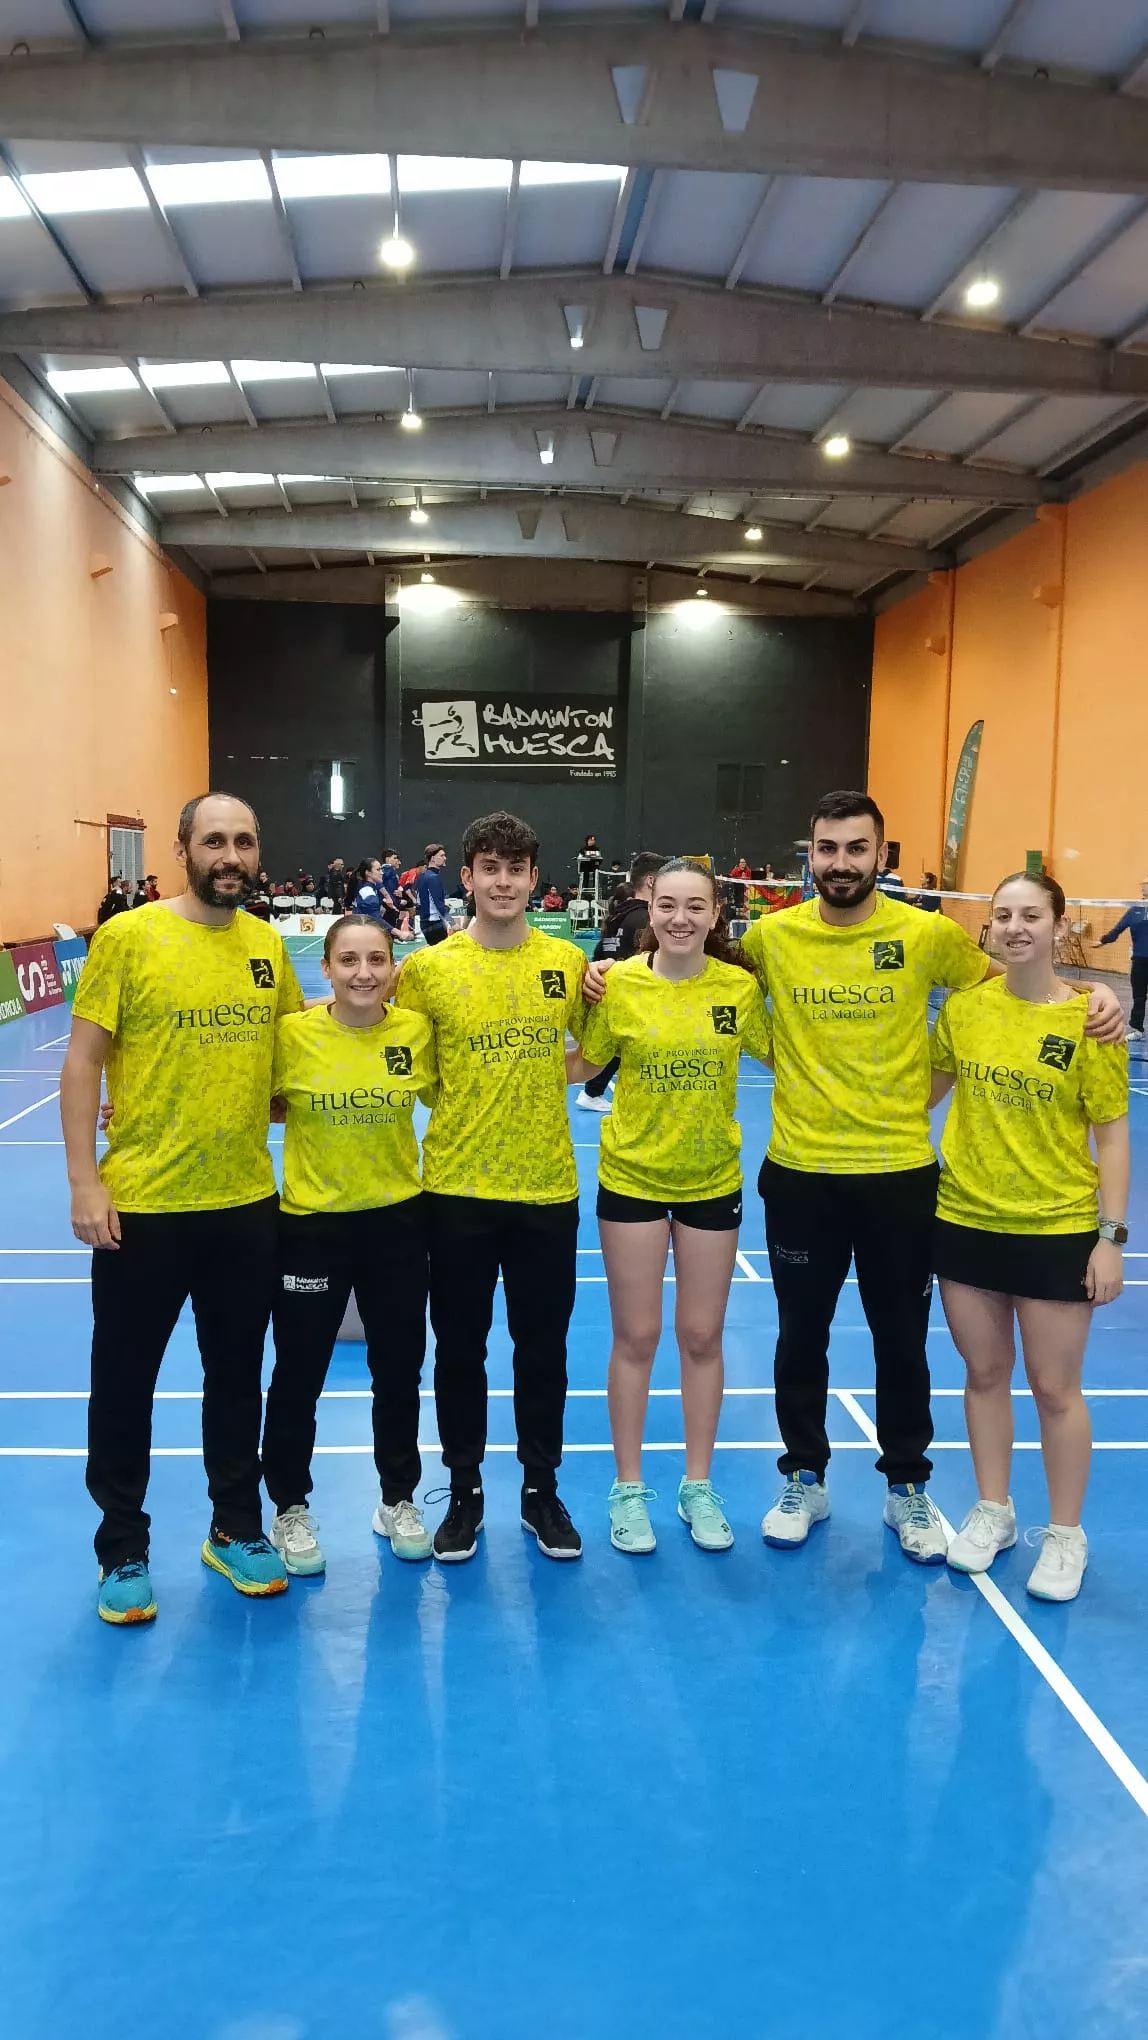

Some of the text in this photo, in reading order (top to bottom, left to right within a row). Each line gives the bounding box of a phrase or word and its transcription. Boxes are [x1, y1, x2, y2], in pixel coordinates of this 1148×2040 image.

[482, 703, 613, 729] BADMiNTON
[483, 732, 615, 760] HUESCA
[792, 984, 896, 1004] Huesca
[175, 1003, 272, 1029] Huesca
[467, 1025, 559, 1052] Huesca
[640, 1059, 724, 1080] Huesca
[959, 1059, 1055, 1102] Huesca
[310, 1087, 414, 1112] Huesca
